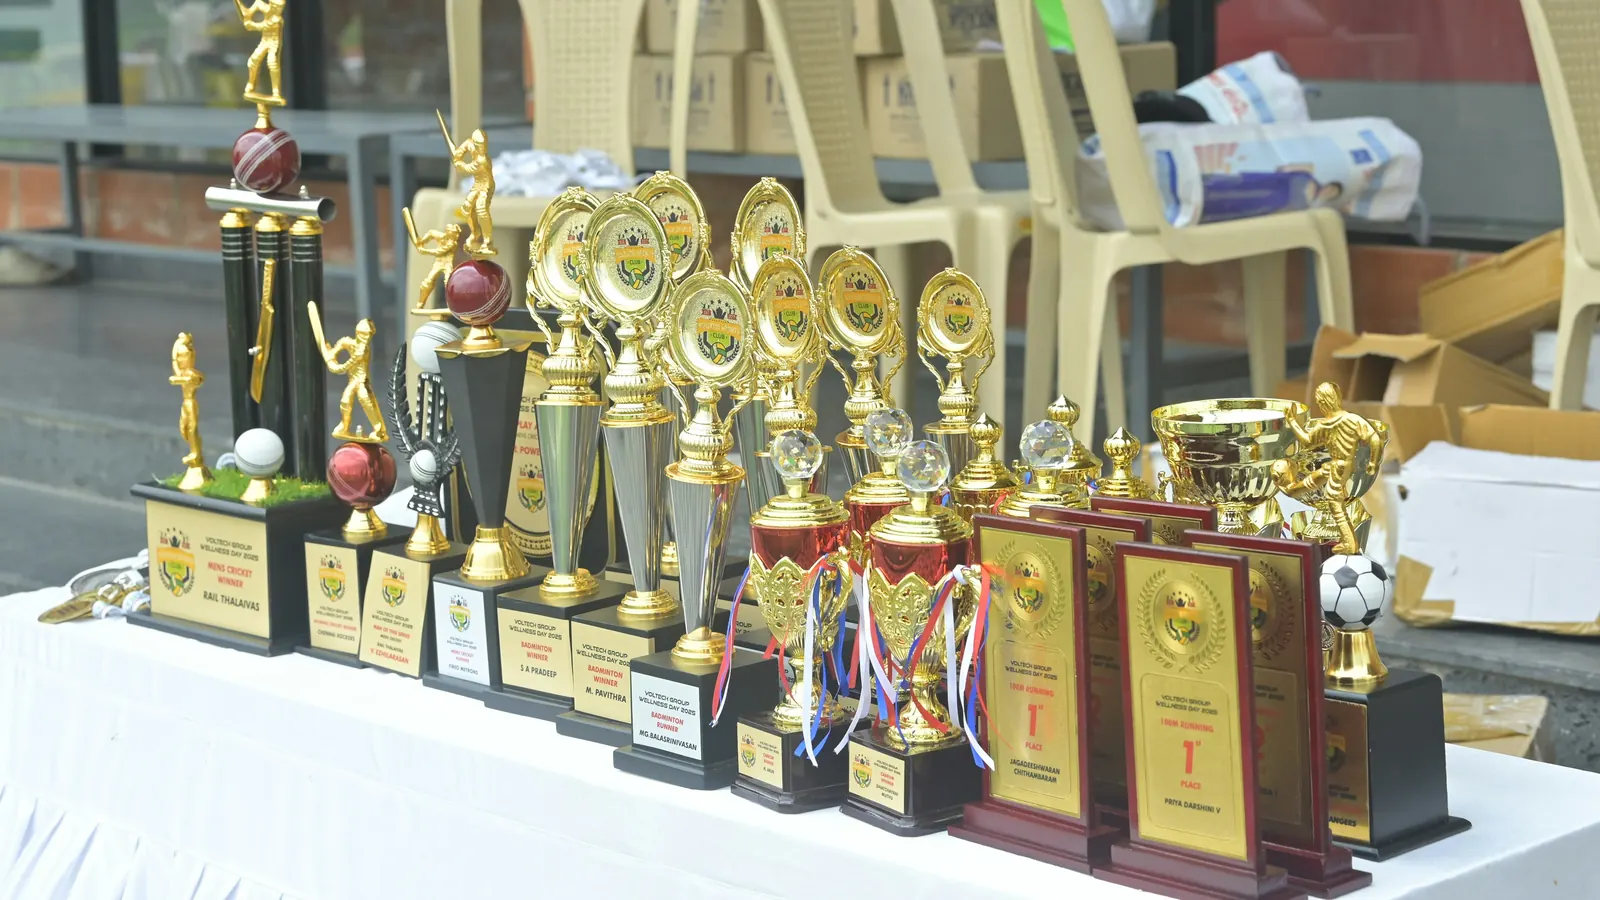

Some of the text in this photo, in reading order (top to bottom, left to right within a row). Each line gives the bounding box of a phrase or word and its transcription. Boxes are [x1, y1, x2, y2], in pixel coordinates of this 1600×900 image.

[520, 446, 540, 456] POWE
[206, 536, 252, 551] VOLTECH GROUP
[200, 544, 229, 555] WELLNESS
[244, 553, 258, 561] 2025
[208, 562, 252, 577] MENS CRICKET
[218, 576, 244, 588] WINNER
[204, 591, 260, 611] RAIL THALAIVAS
[509, 625, 536, 636] WELLNESS
[514, 619, 556, 631] VOLTECH GROUP
[521, 641, 552, 652] BADMINTON
[582, 643, 628, 658] VOLTECH GROUP
[527, 651, 548, 661] WINNER
[576, 649, 606, 661] WELLNESS
[619, 659, 630, 667] 202
[1005, 666, 1032, 676] WELLNESS
[1011, 660, 1052, 671] VOLTECH GROUP
[531, 667, 557, 678] PRADEEP
[588, 665, 623, 679] BADMINTON
[594, 676, 618, 687] WINNER
[595, 689, 627, 703] PAVITHRA
[1026, 686, 1054, 697] RUNNING
[645, 691, 689, 706] VOLTECH GROUP
[1162, 694, 1188, 703] VOLTECH
[639, 696, 668, 708] WELLNESS
[680, 708, 696, 716] 2025
[1156, 701, 1187, 710] WELLNESS
[651, 712, 684, 725] BADMINTON
[657, 722, 678, 732] RUNNER
[1180, 722, 1214, 733] RUNNING
[1025, 742, 1042, 751] PLACE
[1010, 759, 1060, 775] JAGADEESHWARAN
[1014, 769, 1057, 783] CHITHAMBARAM
[1181, 780, 1201, 790] PLACE
[1165, 798, 1182, 807] PRIYA
[1184, 800, 1214, 812] DARSHINI
[1329, 816, 1356, 827] ANGERS
